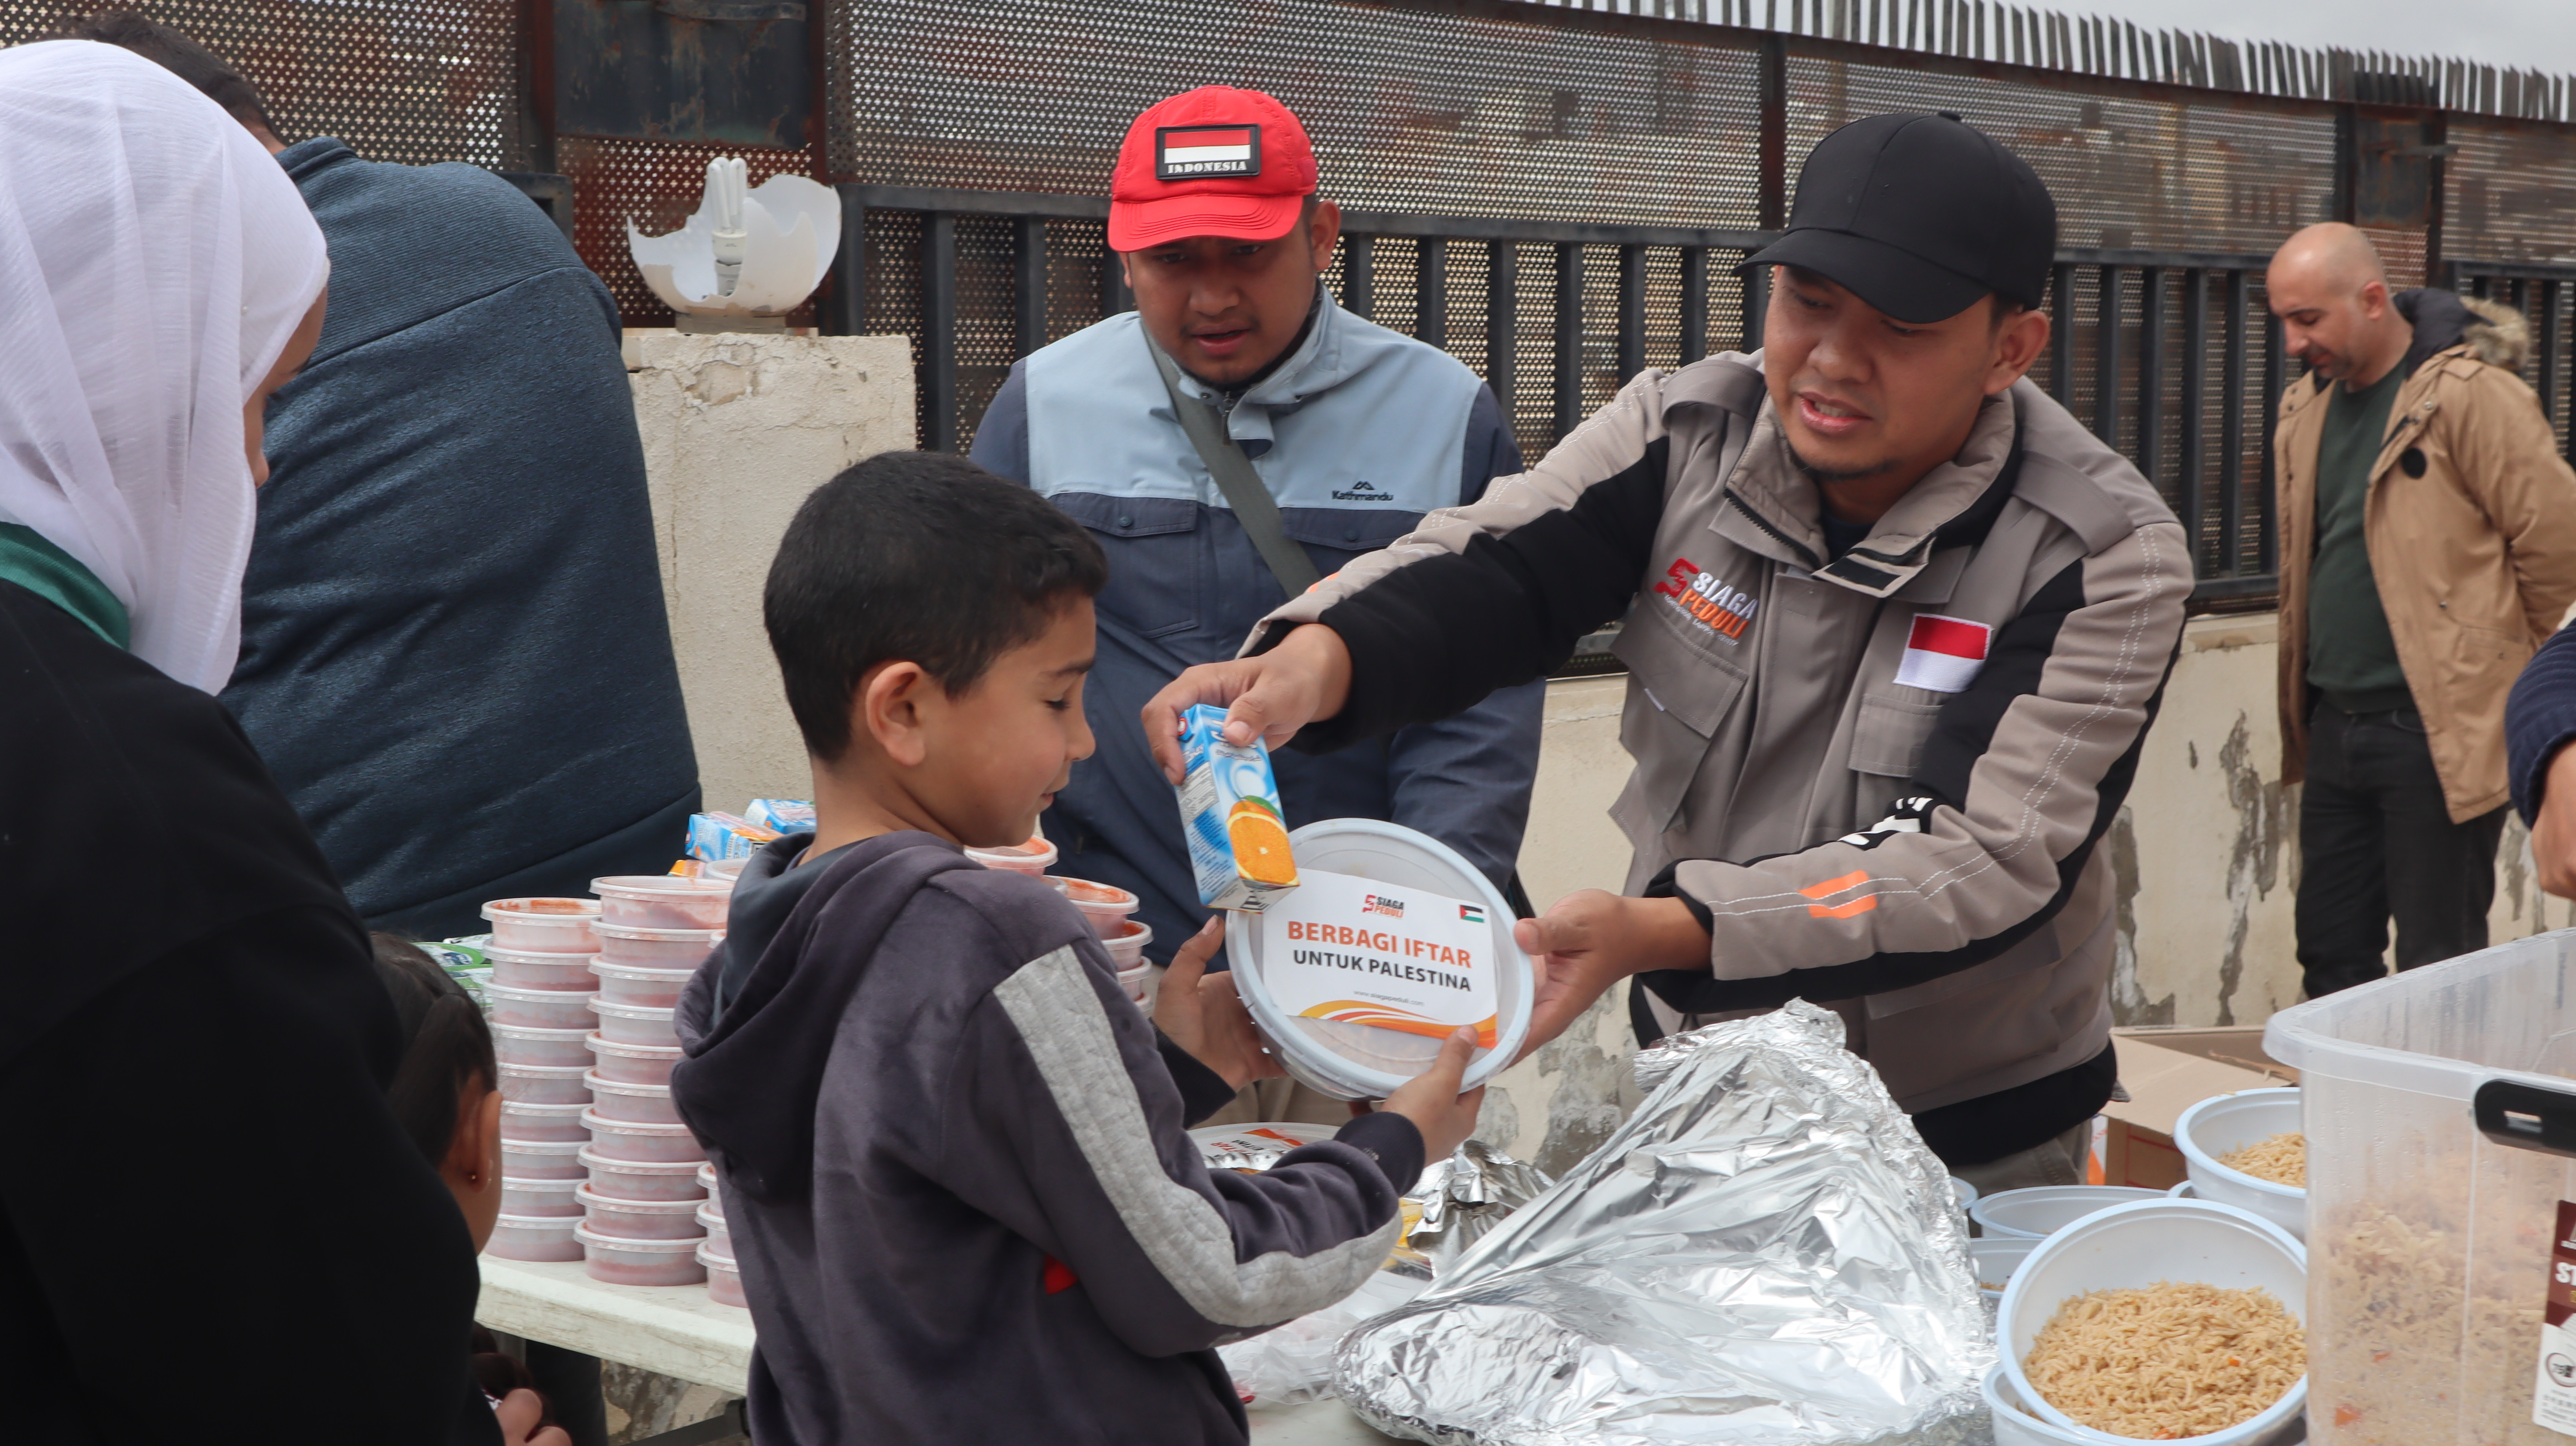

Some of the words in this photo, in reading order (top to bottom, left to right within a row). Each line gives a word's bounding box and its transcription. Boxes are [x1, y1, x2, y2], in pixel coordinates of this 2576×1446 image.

[1167, 161, 1247, 174] INDONESIA
[1332, 490, 1394, 501] Kathmandu
[1692, 572, 1759, 621] SIAGA
[1678, 588, 1749, 639] PEDULI
[1374, 905, 1404, 918] PEDULI
[1376, 896, 1404, 910] SIAGA
[1288, 920, 1397, 953] BERBAGI
[1404, 937, 1472, 969] IFTAR
[1294, 950, 1364, 972] UNTUK
[1369, 958, 1472, 992] PALESTINA
